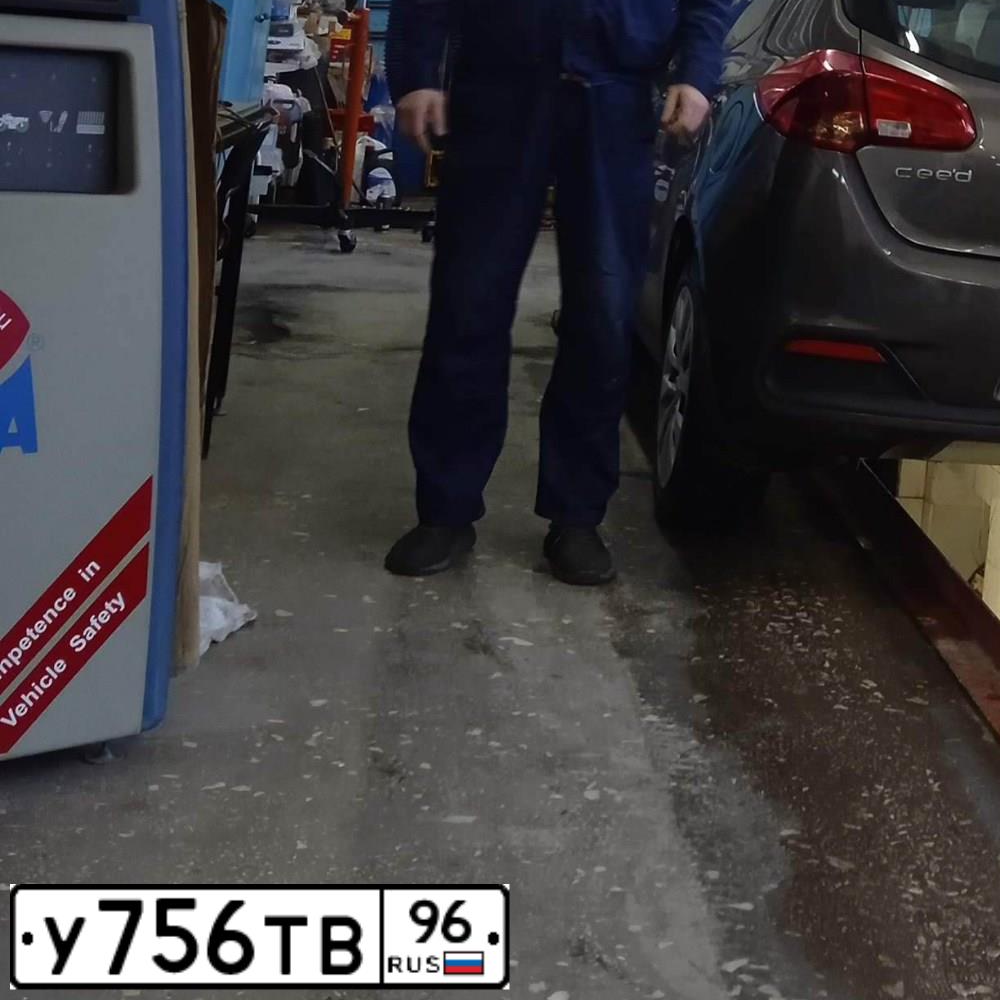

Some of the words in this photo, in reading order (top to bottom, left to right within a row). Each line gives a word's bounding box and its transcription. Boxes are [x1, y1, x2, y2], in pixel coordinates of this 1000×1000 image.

[77, 560, 101, 582] in
[0, 658, 67, 728] Vehicle
[69, 591, 126, 653] Safety
